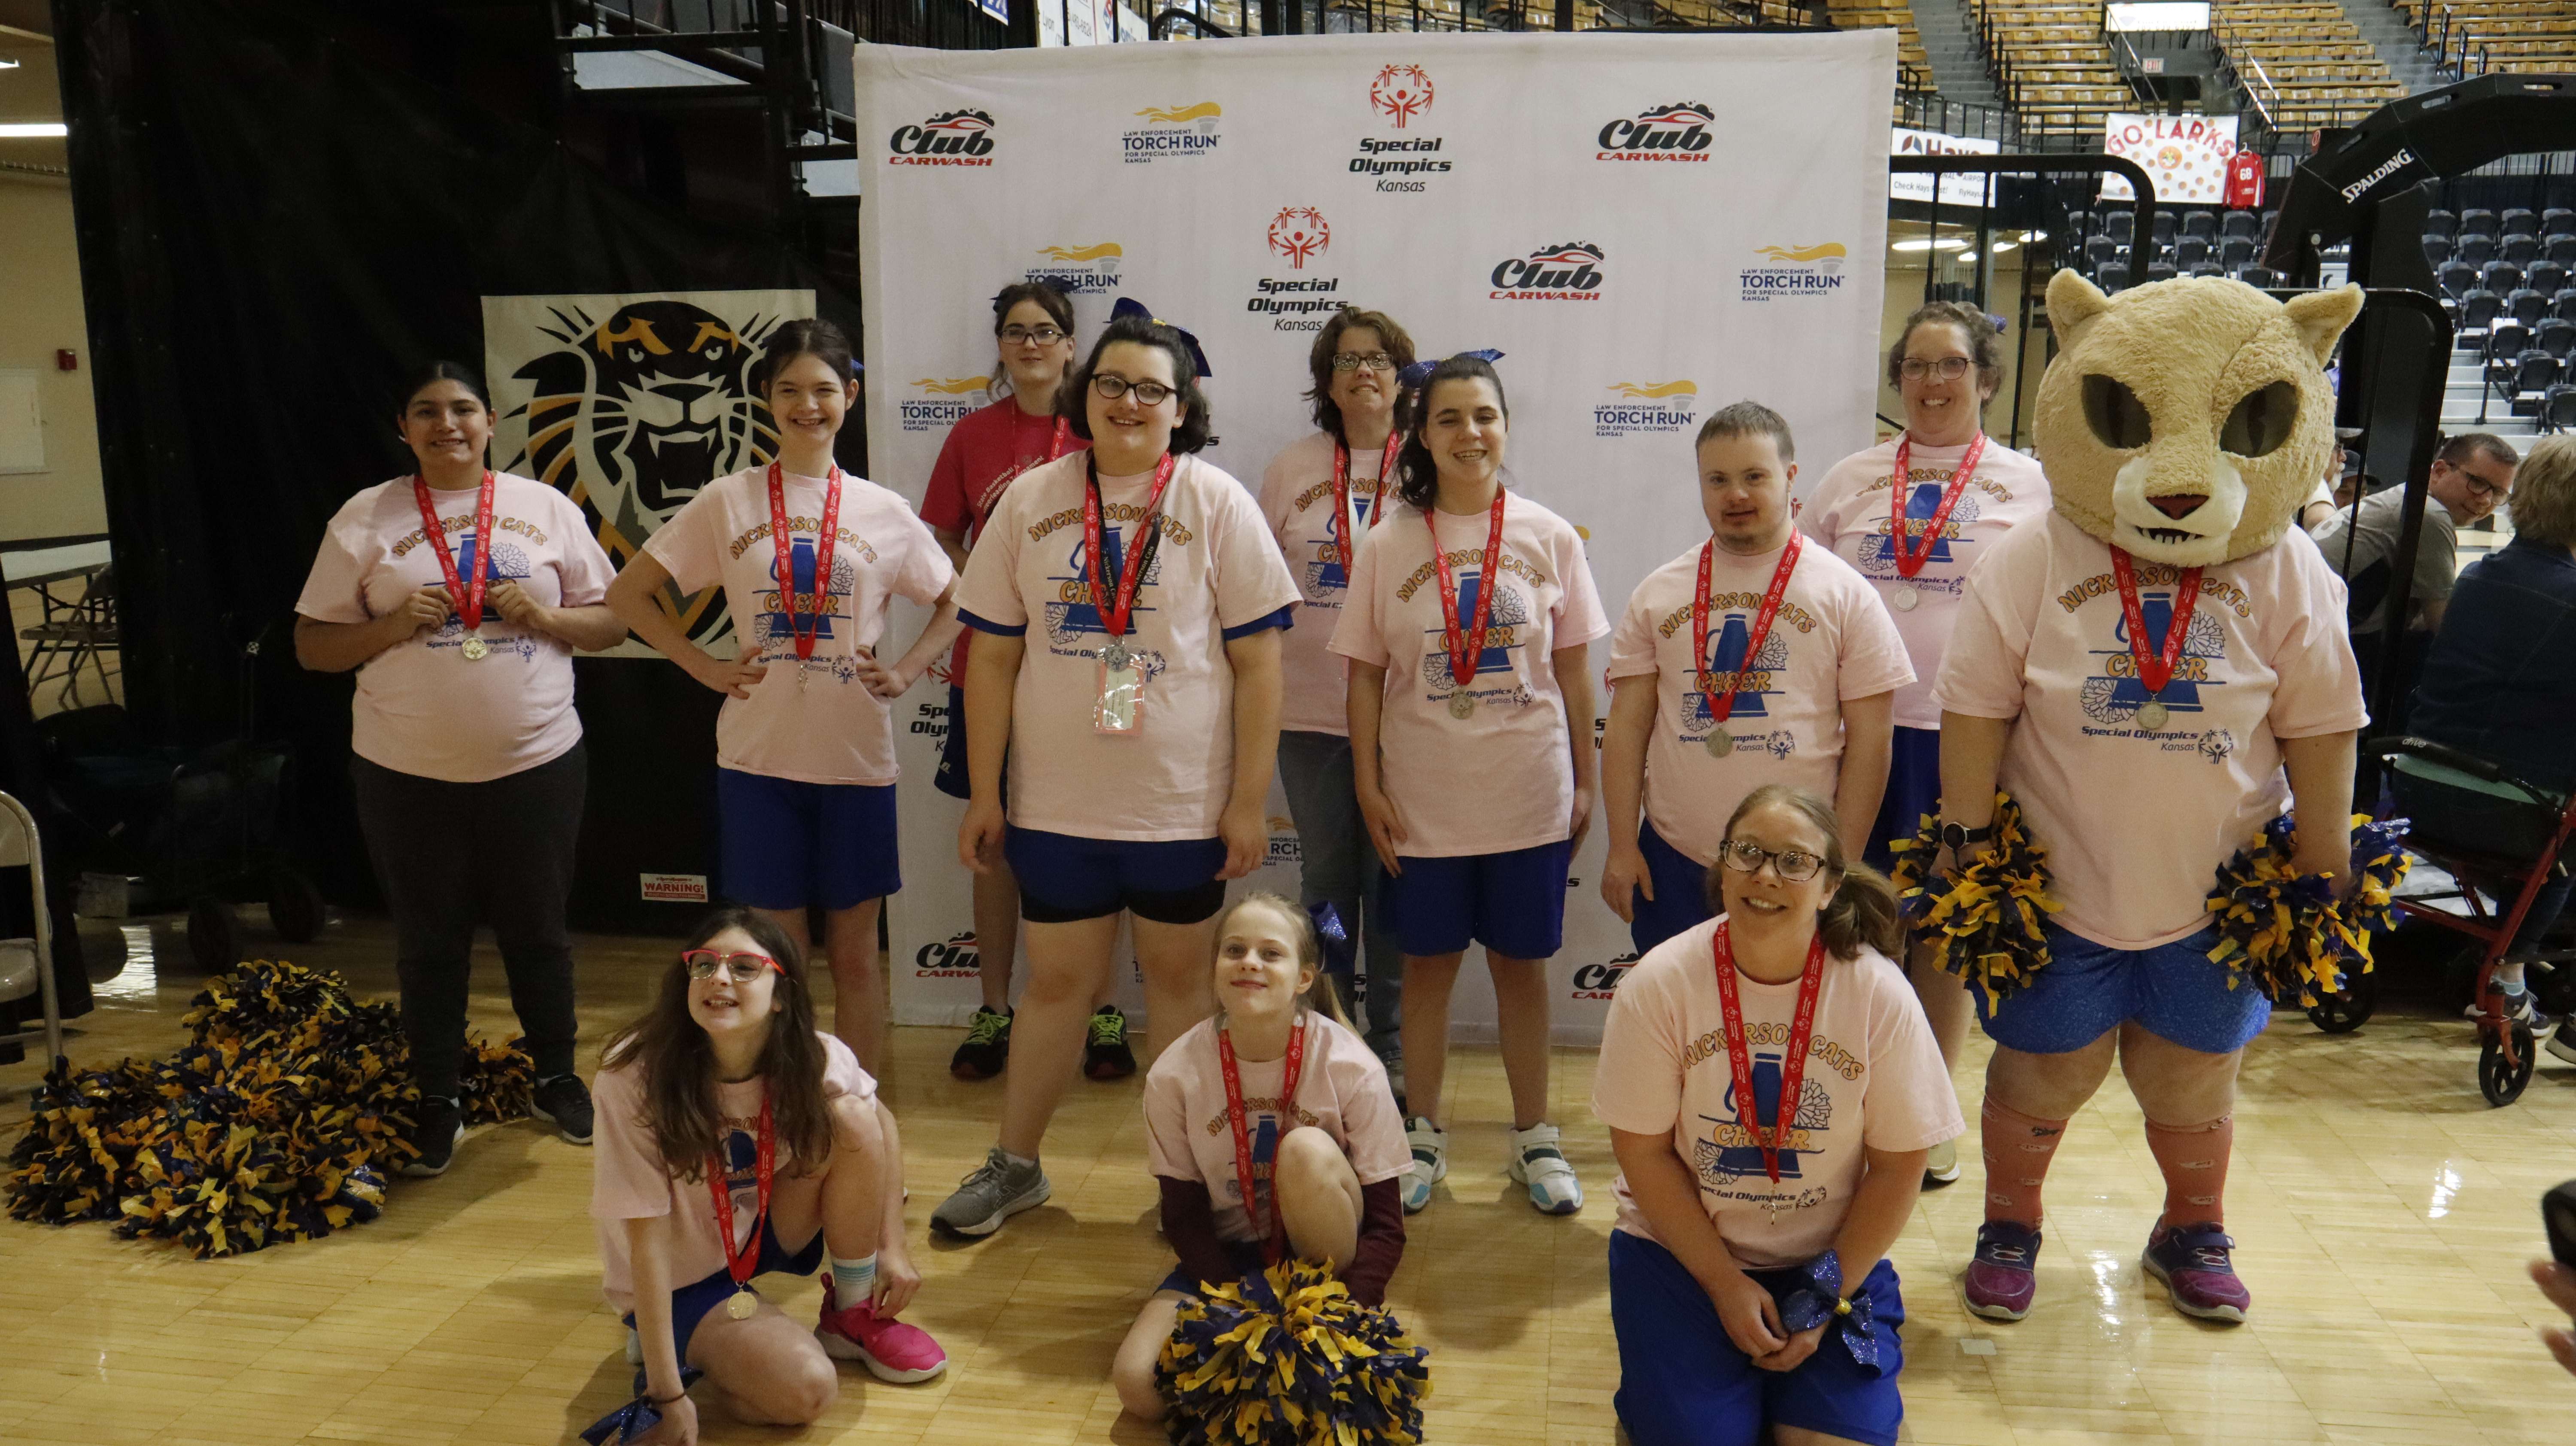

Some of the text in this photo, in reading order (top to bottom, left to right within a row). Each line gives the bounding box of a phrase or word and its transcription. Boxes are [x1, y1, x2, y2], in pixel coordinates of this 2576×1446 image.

[2147, 61, 2160, 71] EXIT
[890, 125, 994, 156] Club
[1122, 135, 1217, 150] TORCH RUN
[1598, 119, 1713, 152] Club
[2107, 118, 2236, 158] GO LARKS
[1359, 138, 1442, 155] Special
[889, 156, 993, 166] CARWASH
[1596, 152, 1710, 162] CARWASH
[1349, 158, 1452, 175] Olympics
[2342, 148, 2413, 204] SPALDING
[1376, 179, 1425, 192] Kansas
[1894, 181, 1914, 191] Check
[1085, 274, 1118, 287] RUN
[1491, 258, 1603, 290] Club
[1258, 278, 1338, 295] Special
[1740, 275, 1841, 288] TORCH RUN
[1489, 291, 1600, 301] CARWASH
[1247, 298, 1349, 315] Olympics
[1273, 318, 1323, 331] Kansas
[900, 406, 954, 419] TORCH
[1594, 411, 1692, 425] TORCH RUN
[977, 492, 987, 508] State
[985, 466, 1015, 493] Basketball
[501, 517, 548, 546] CATS
[835, 527, 878, 564] CATS
[1103, 556, 1115, 587] Nickerson
[1498, 555, 1546, 588] CATS
[1917, 583, 1947, 592] Kansas
[1303, 599, 1330, 609] Special
[2198, 577, 2251, 618] CATS
[804, 663, 830, 672] Kansas
[1466, 687, 1512, 700] Olympics
[1486, 697, 1512, 705] Kansas
[2081, 726, 2199, 741] Special Olympics
[2160, 742, 2195, 751] Kansas
[2402, 738, 2427, 748] drive
[644, 882, 704, 893] WARNING!
[916, 943, 980, 968] Clu
[1807, 1035, 1865, 1081] CATS
